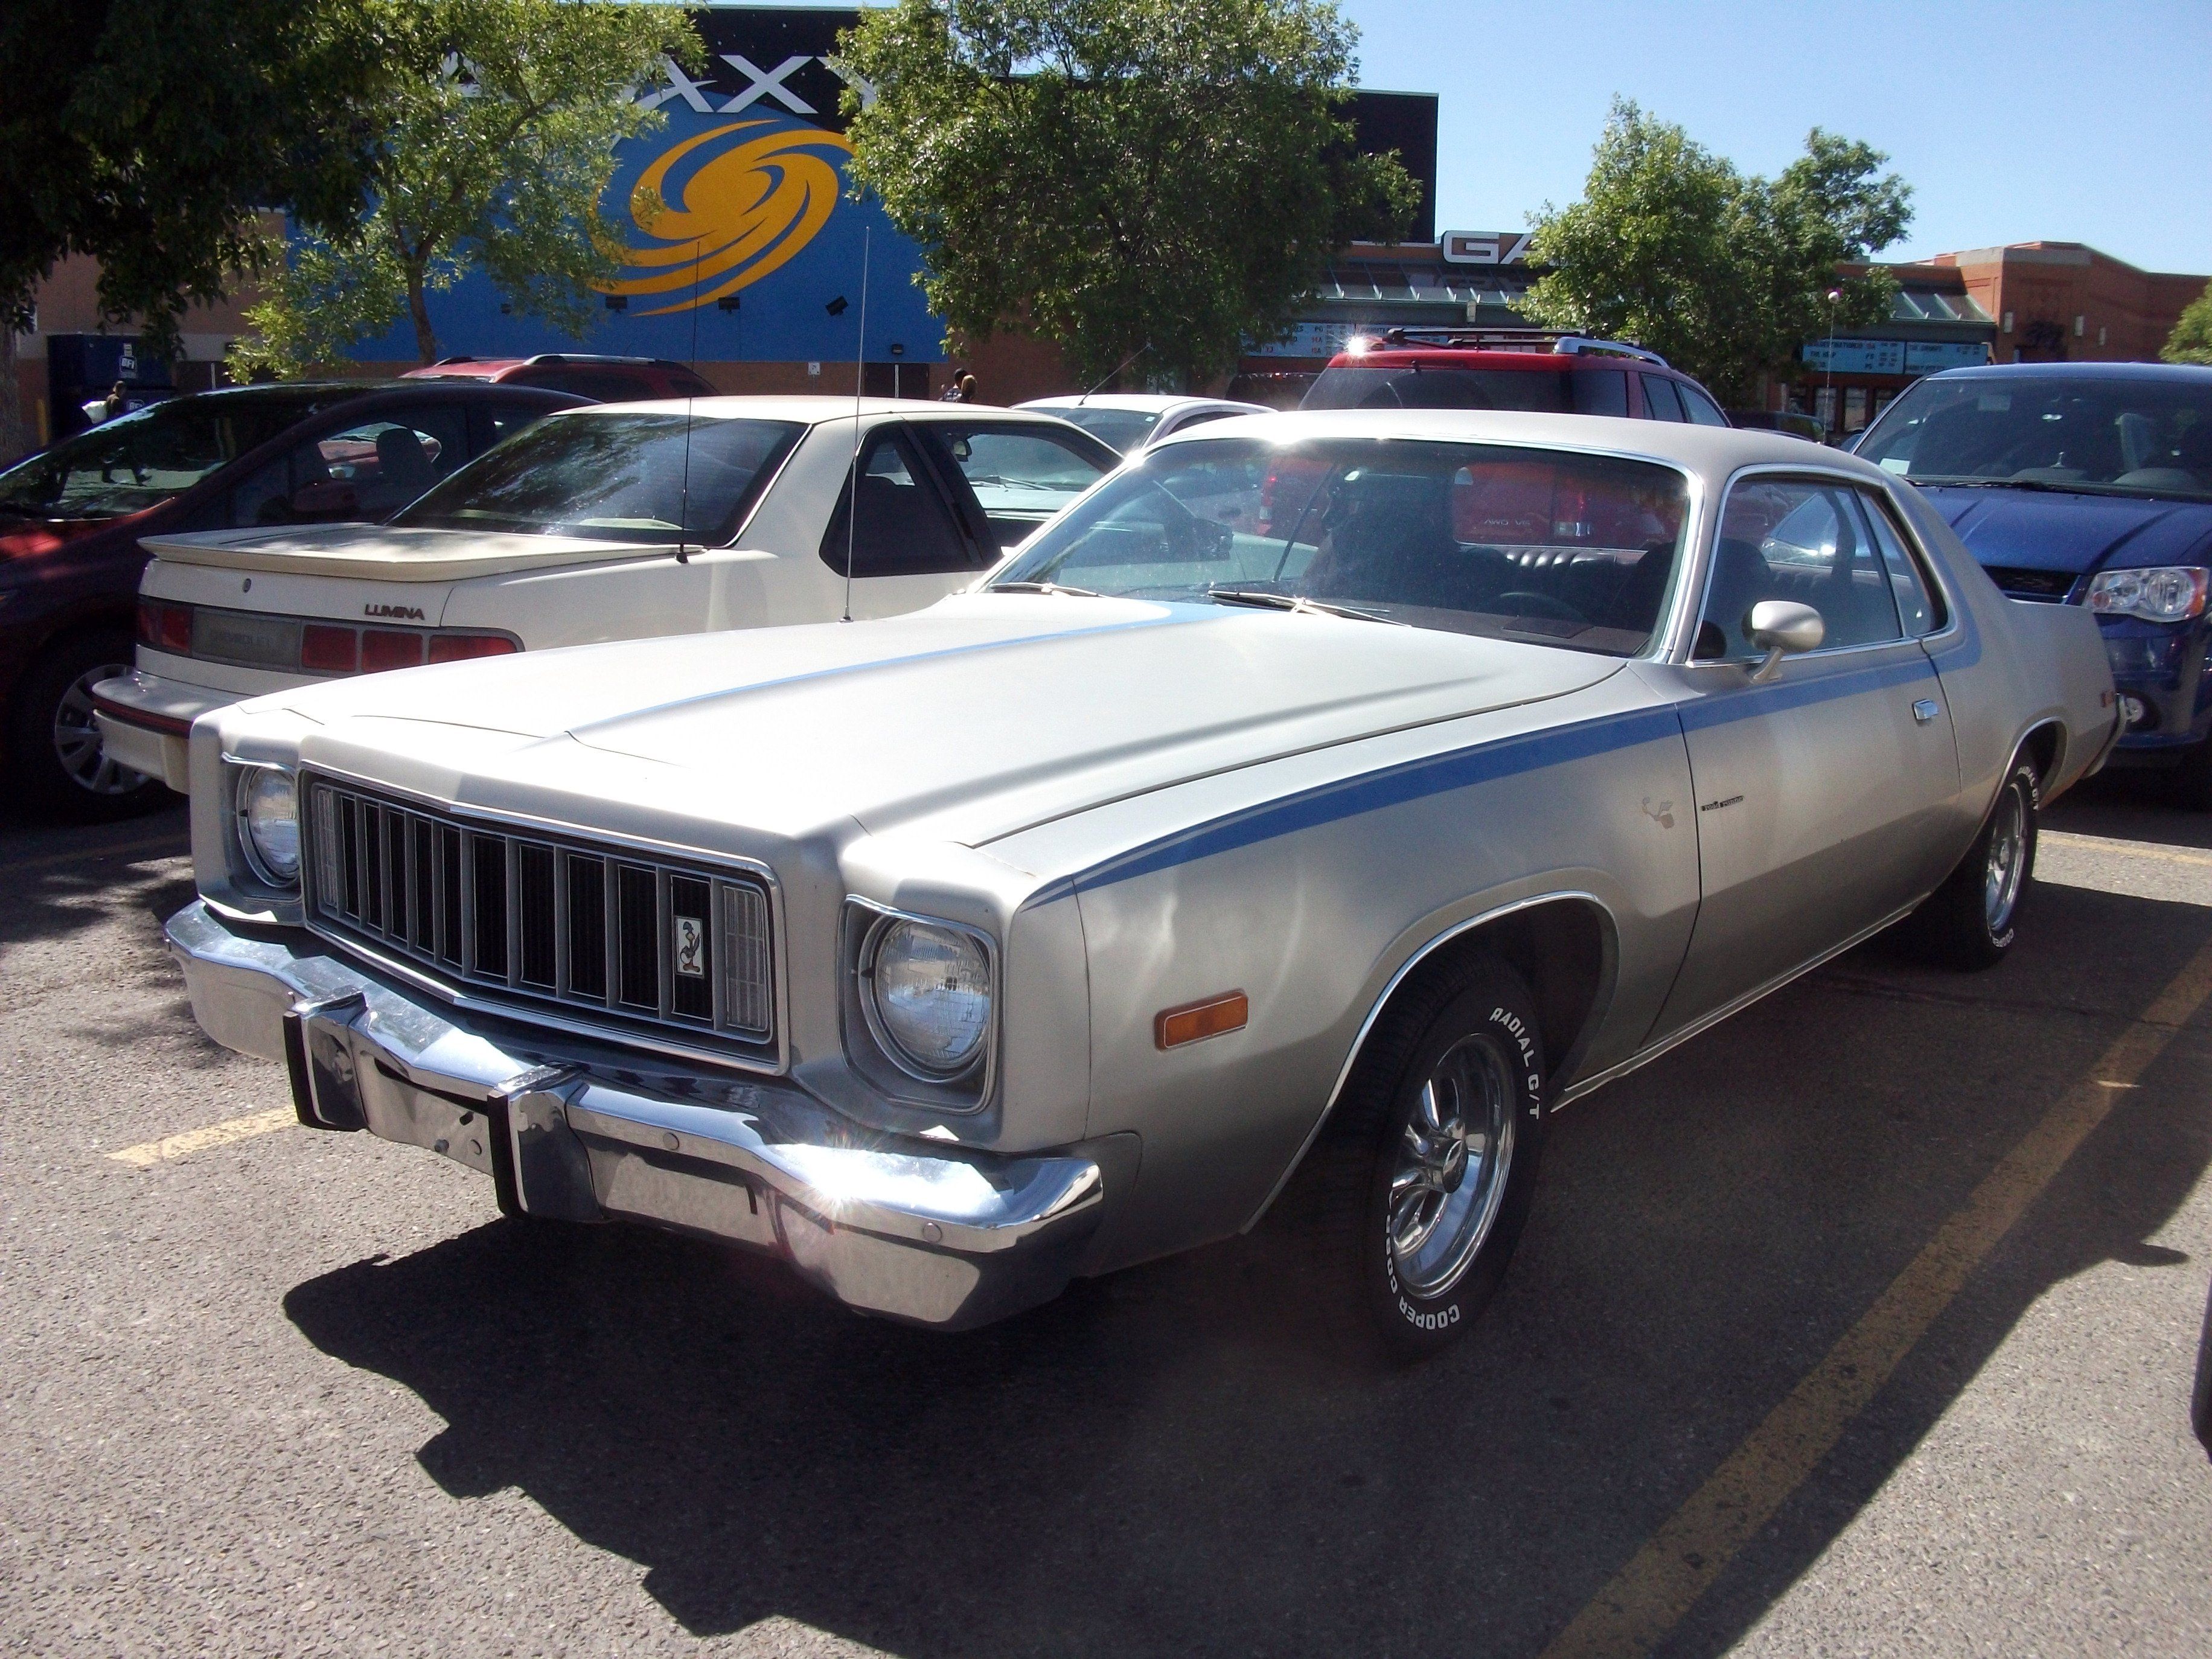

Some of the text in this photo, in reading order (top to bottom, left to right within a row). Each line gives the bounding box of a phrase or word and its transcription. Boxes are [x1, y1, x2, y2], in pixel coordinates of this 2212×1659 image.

[365, 604, 426, 620] LUMINA
[1488, 1007, 1540, 1120] RADIAL G/T
[1398, 1295, 1460, 1329] COOPER
